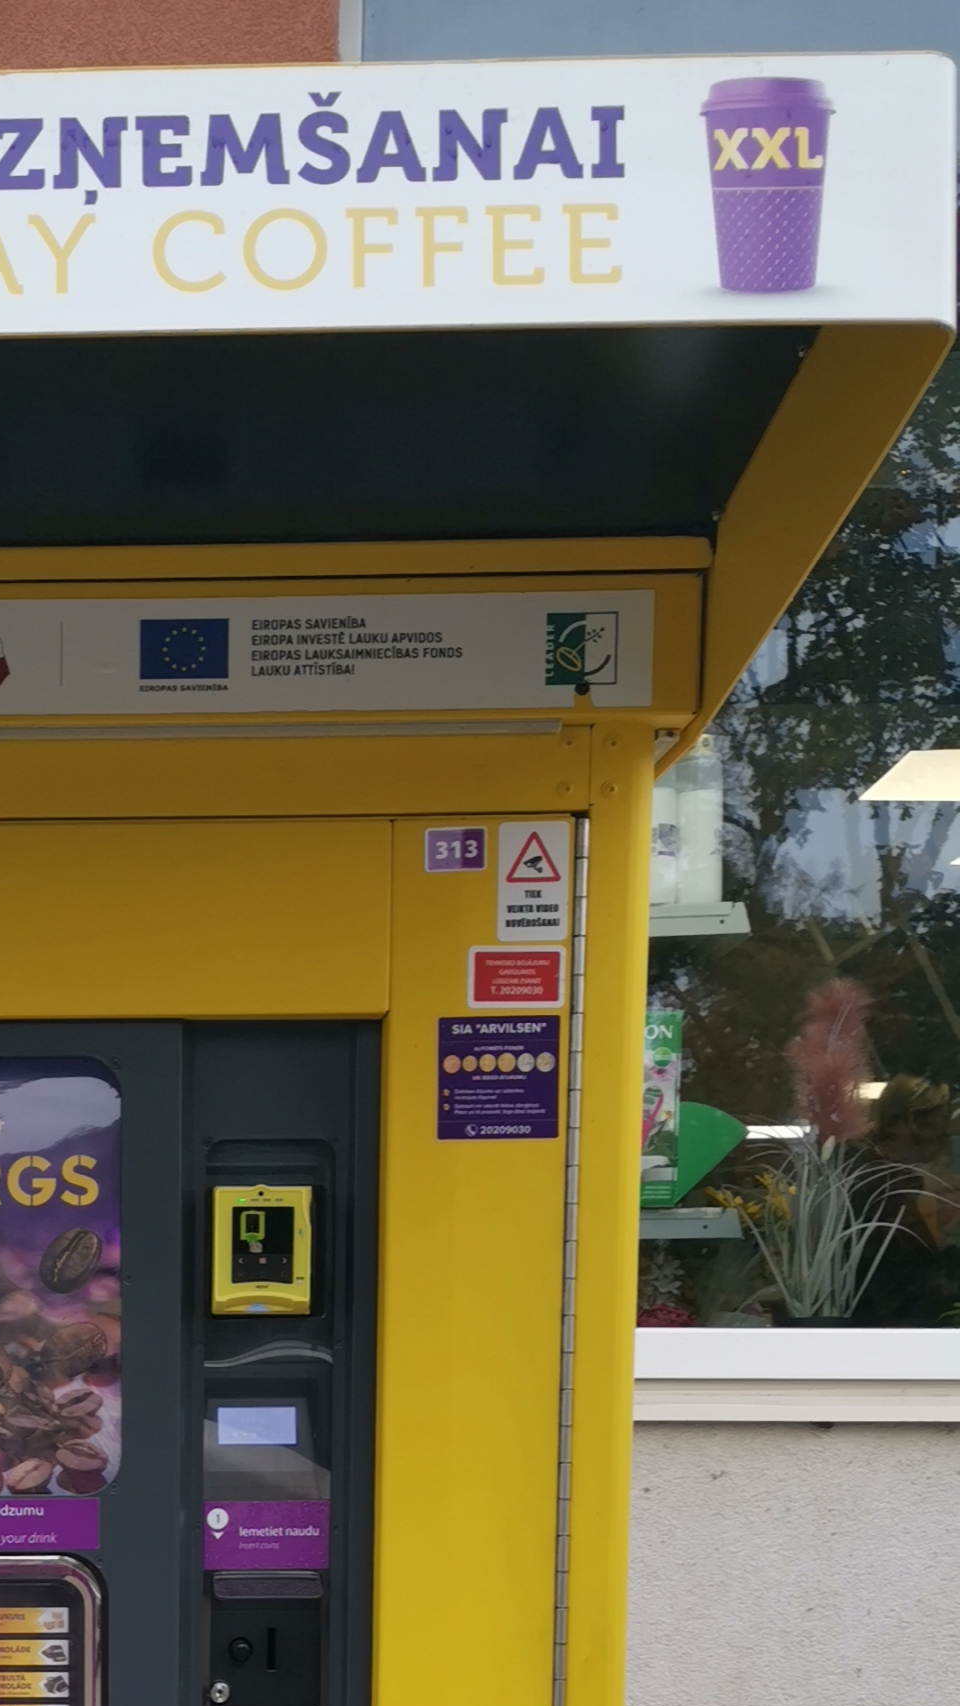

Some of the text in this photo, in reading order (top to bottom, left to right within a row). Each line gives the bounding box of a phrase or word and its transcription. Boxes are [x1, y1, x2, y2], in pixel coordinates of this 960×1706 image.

[712, 126, 825, 171] XXL
[152, 203, 623, 294] COFFEE
[252, 617, 367, 631] EIROPAS SAVIENĪBA
[252, 631, 443, 646] EIROPA INVESTĒ LAUKU APVIDOS
[252, 645, 464, 661] EIROPAS LAUKSAIMNIECĪBAS FONDS
[544, 624, 556, 678] LEADER
[251, 662, 355, 677] LAUKU ATTĪSTĪBA!
[139, 683, 229, 692] EIROPAS SAVIENĪBA
[434, 840, 478, 860] 313
[524, 889, 543, 899] TIEK
[499, 985, 544, 996] 20209030
[451, 1022, 547, 1035] SIA "ARVILSEN"
[479, 1125, 531, 1135] 20209030
[215, 1513, 221, 1524] 1
[238, 1525, 320, 1537] Iemetiet naudu
[0, 1535, 25, 1547] your
[26, 1532, 57, 1544] drink
